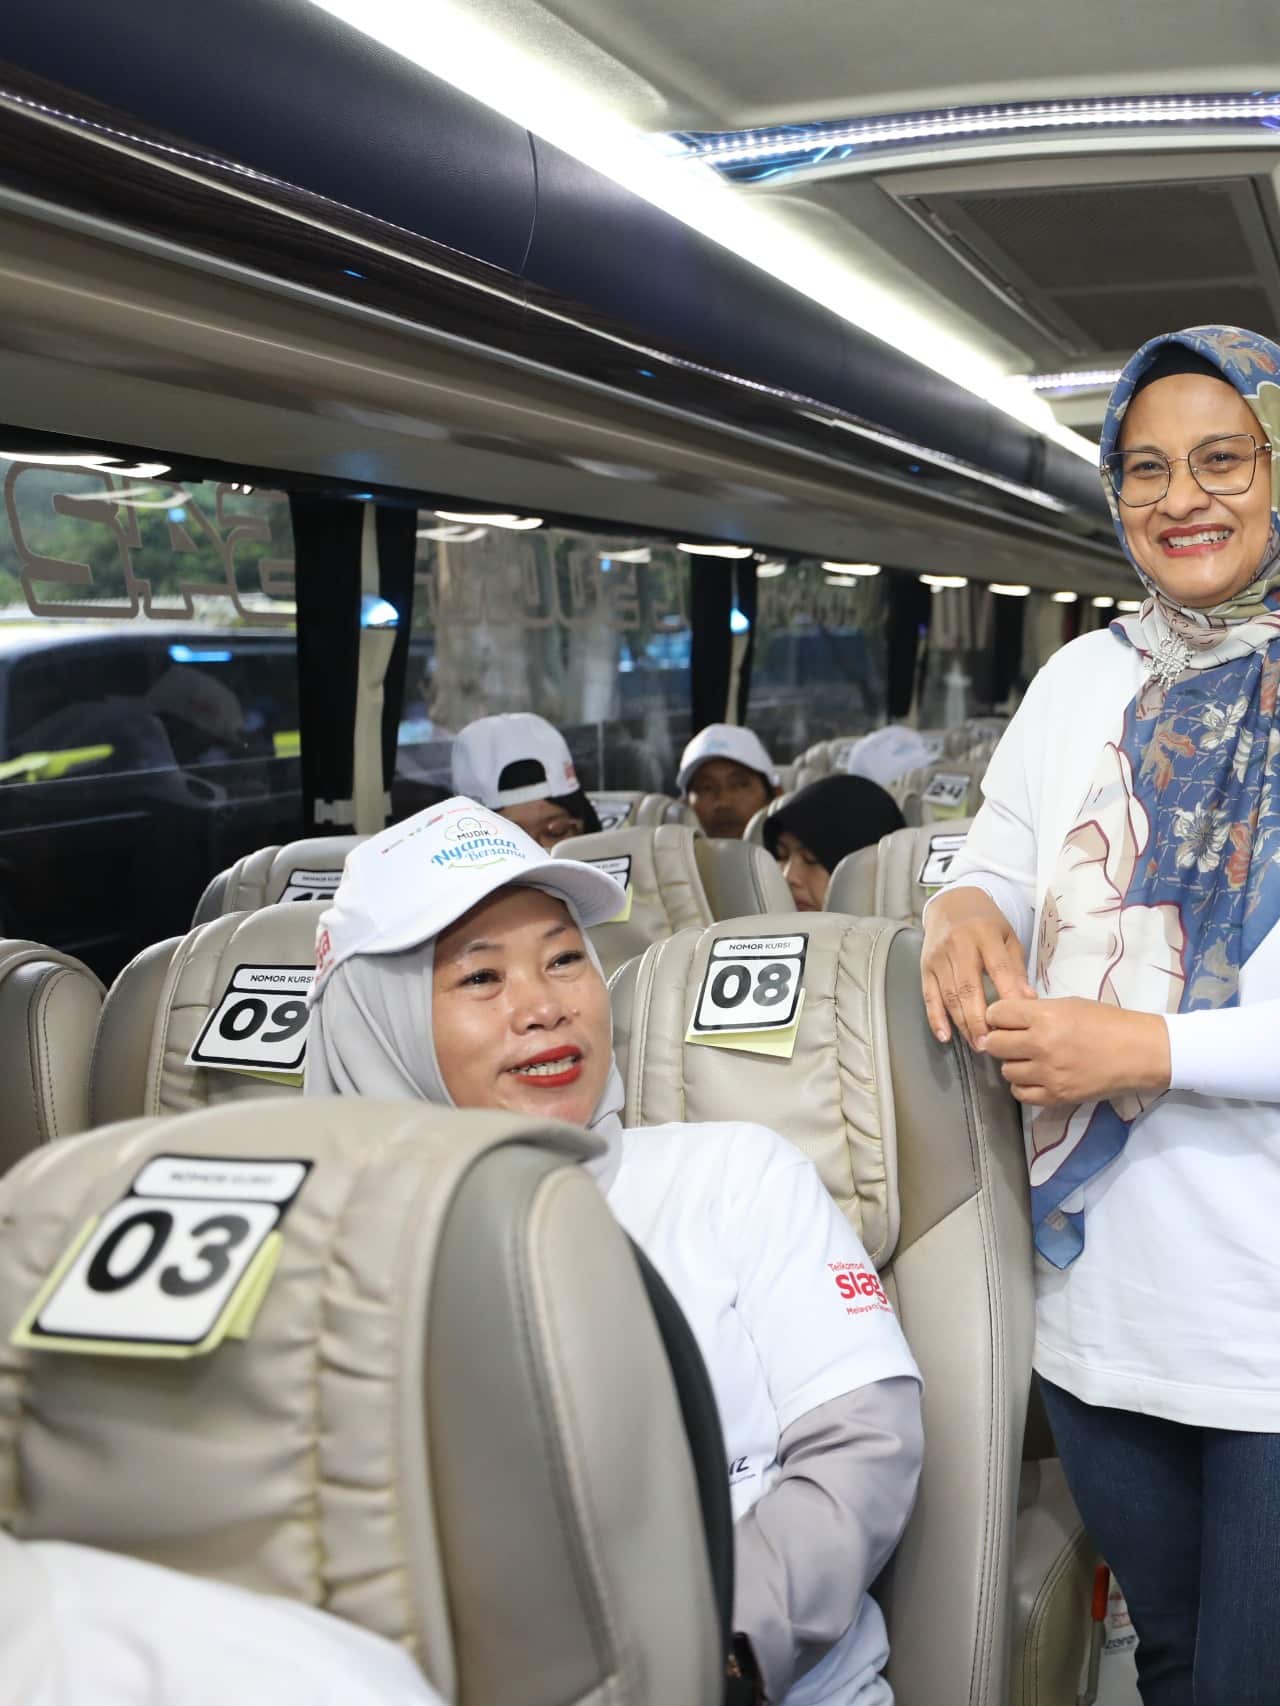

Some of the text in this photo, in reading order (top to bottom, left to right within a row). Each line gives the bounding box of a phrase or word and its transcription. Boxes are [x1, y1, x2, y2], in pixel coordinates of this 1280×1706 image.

[456, 829, 490, 840] MUDIK
[431, 838, 520, 866] Nyaman
[728, 942, 791, 951] NOMOR KURSI
[249, 974, 286, 983] NOMOR
[710, 962, 792, 1009] 08
[218, 997, 311, 1043] 09
[85, 1208, 251, 1298] 03
